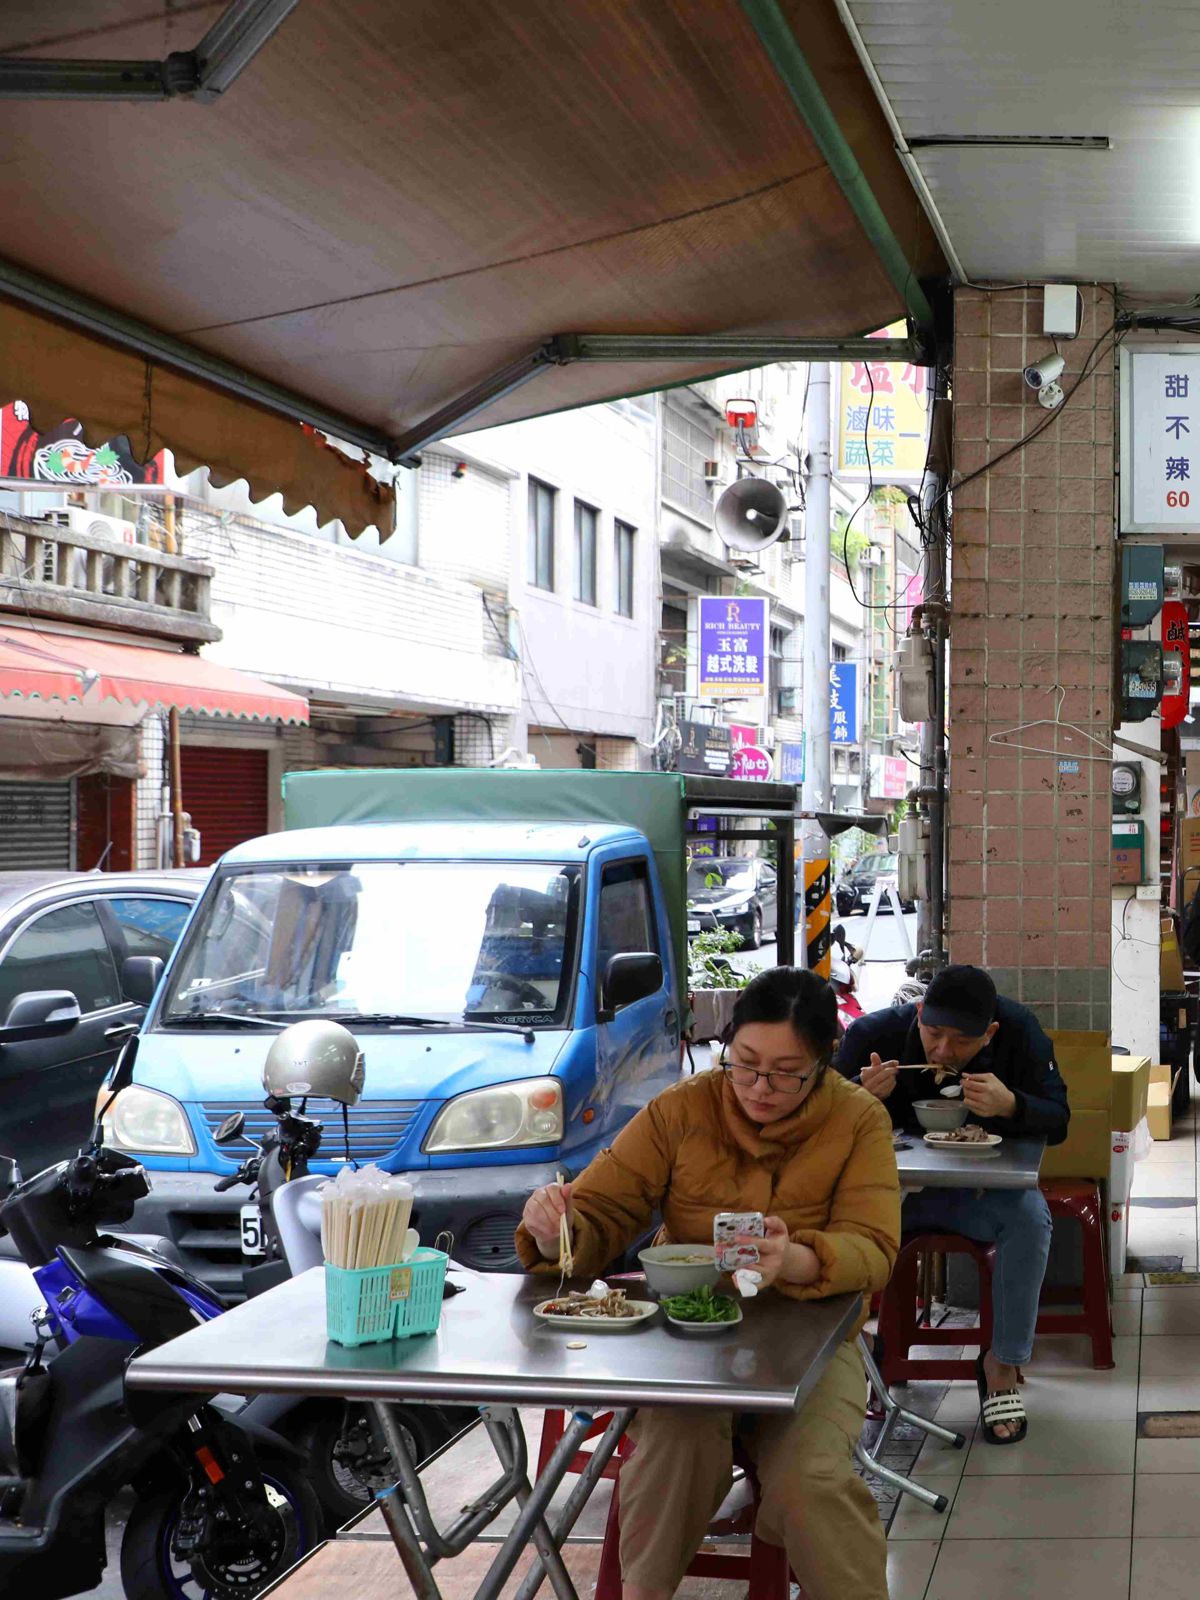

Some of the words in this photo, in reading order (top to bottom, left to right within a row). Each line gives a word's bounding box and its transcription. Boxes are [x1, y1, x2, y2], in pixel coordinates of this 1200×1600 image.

[846, 405, 895, 432] 滷味
[1165, 374, 1190, 481] 甜不辣
[844, 440, 894, 465] 蔬菜
[1165, 491, 1190, 507] 60
[705, 622, 725, 630] RICH
[728, 622, 760, 630] BEAUTY
[707, 654, 758, 673] 越式洗髮
[494, 1015, 554, 1025] VERYCA
